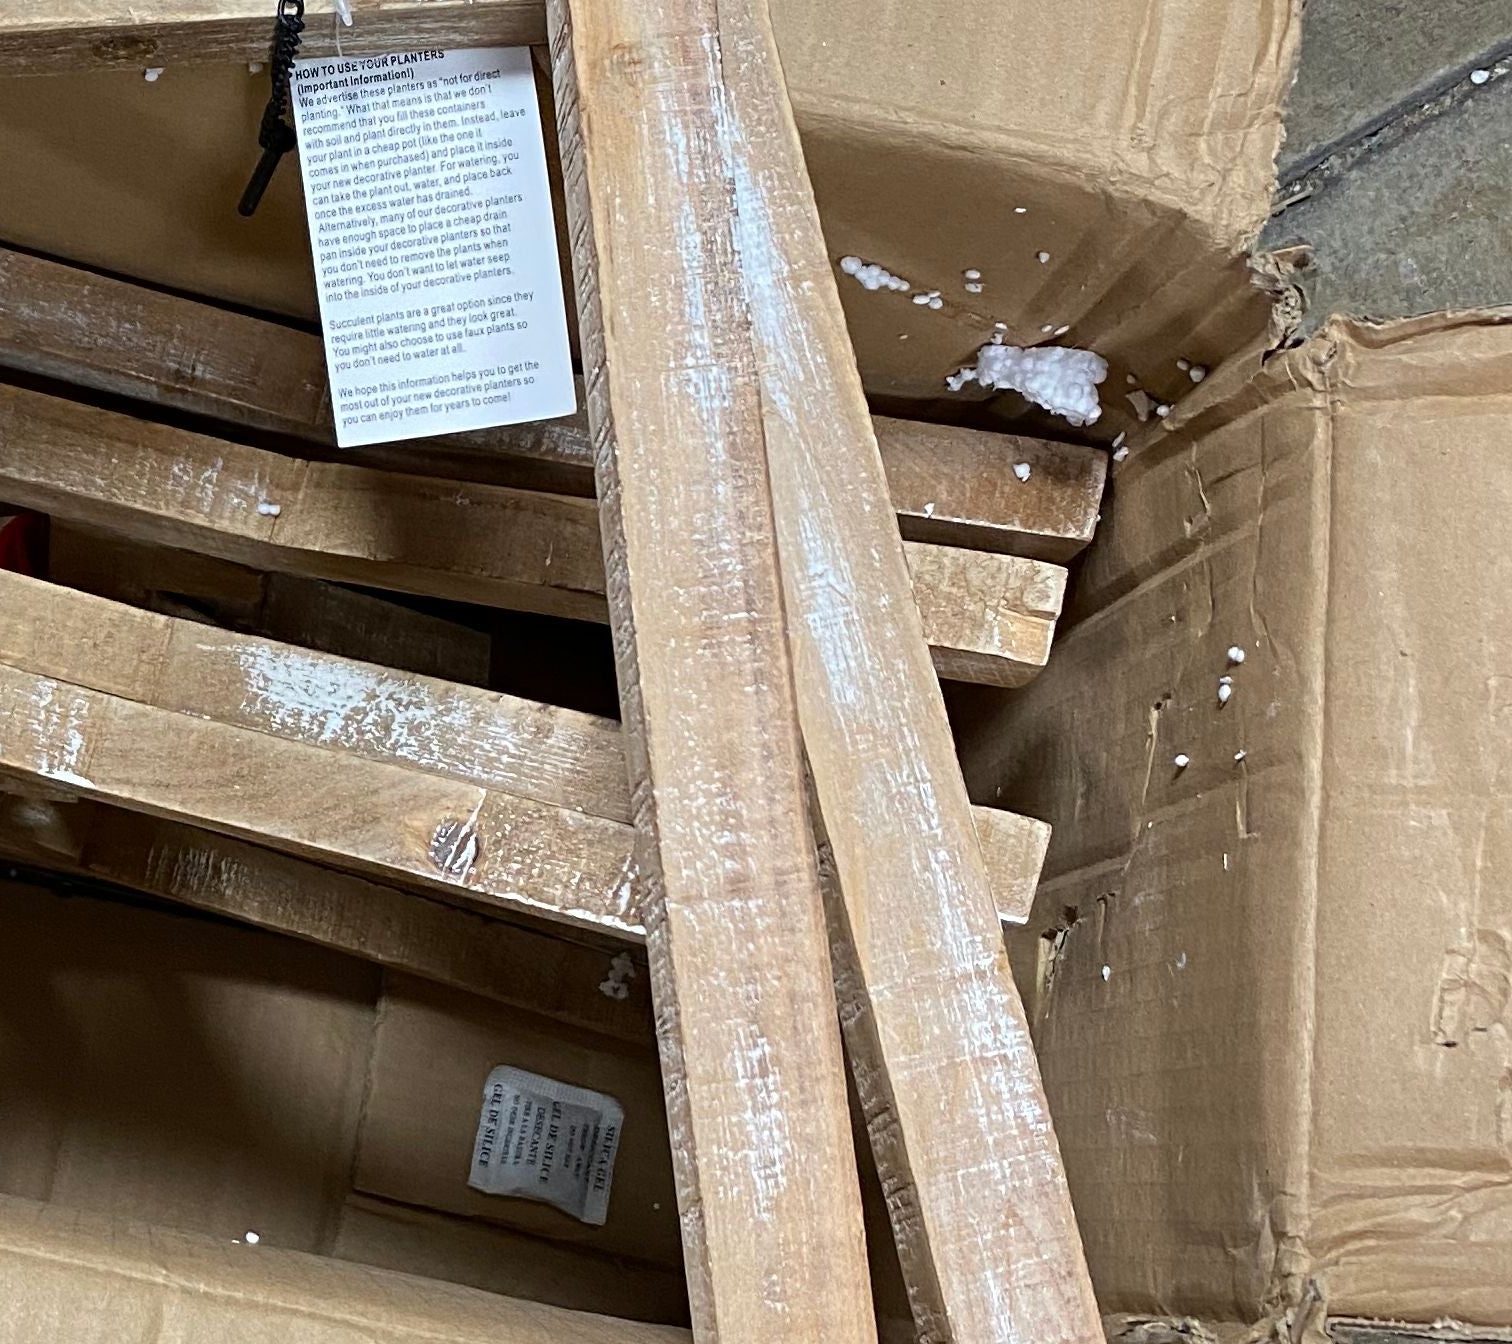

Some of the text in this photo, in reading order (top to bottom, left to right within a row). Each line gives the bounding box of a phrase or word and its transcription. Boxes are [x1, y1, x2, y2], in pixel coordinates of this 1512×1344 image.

[294, 66, 319, 80] HOW
[336, 61, 358, 73] USE
[358, 55, 388, 69] YOUR
[390, 48, 444, 65] PLANTERS
[316, 90, 358, 105] advertise
[359, 87, 385, 98] these
[387, 81, 424, 96] planters
[459, 73, 472, 83] for
[473, 69, 500, 80] direct
[345, 102, 370, 115] What
[371, 99, 390, 111] that
[391, 96, 422, 107] means
[432, 90, 452, 101] that
[308, 166, 339, 177] comes
[350, 159, 375, 171] when
[377, 150, 429, 168] purchased)
[430, 146, 448, 158] and
[449, 144, 475, 157] place
[484, 138, 512, 150] inside
[310, 181, 330, 194] your
[332, 178, 351, 188] new
[353, 170, 401, 184] decorative
[439, 160, 456, 171] For
[501, 152, 519, 164] you
[312, 196, 329, 205] can
[330, 191, 351, 202] take
[352, 189, 367, 199] the
[368, 184, 392, 198] plant
[443, 172, 461, 185] and
[462, 171, 488, 184] place
[489, 165, 512, 177] back
[379, 212, 404, 223] many
[417, 208, 432, 217] our
[434, 200, 483, 214] decorative
[484, 193, 522, 209] planters
[317, 236, 340, 247] have
[342, 230, 376, 243] enough
[378, 226, 406, 239] space
[418, 220, 443, 233] place
[453, 214, 482, 226] cheap
[482, 209, 507, 221] drain
[321, 265, 338, 277] you
[364, 255, 388, 268] need
[400, 250, 435, 262] remove
[436, 247, 451, 257] the
[452, 242, 481, 256] plants
[482, 238, 508, 249] when
[366, 271, 385, 281] You
[411, 263, 434, 275] want
[445, 259, 458, 269] let
[458, 256, 485, 267] water
[486, 253, 510, 263] seep
[329, 315, 374, 330] Succulent
[376, 311, 404, 325] plants
[405, 309, 421, 318] are
[430, 302, 455, 316] great
[456, 298, 485, 311] option
[487, 294, 512, 305] since
[513, 291, 533, 301] they
[330, 331, 363, 344] require
[364, 327, 385, 338] little
[386, 322, 426, 335] watering
[427, 317, 445, 329] and
[446, 316, 466, 326] they
[468, 310, 488, 322] look
[332, 347, 350, 357] You
[351, 342, 377, 355] might
[378, 340, 398, 350] also
[399, 335, 433, 347] choose
[445, 331, 463, 340] use
[464, 327, 484, 337] faux
[486, 322, 514, 335] plants
[340, 400, 363, 412] most
[363, 397, 379, 408] out
[390, 395, 411, 407] your
[412, 392, 432, 401] new
[433, 384, 482, 398] decorative
[483, 378, 521, 393] planters
[354, 385, 378, 396] hope
[378, 381, 396, 392] this
[397, 374, 450, 389] information
[450, 369, 476, 381] helps
[478, 368, 495, 379] you
[507, 362, 523, 375] get
[524, 360, 539, 370] the
[342, 417, 358, 428] you
[359, 414, 377, 422] can
[378, 410, 403, 421] enjoy
[404, 406, 428, 416] them
[429, 403, 442, 412] for
[444, 400, 470, 413] years
[482, 391, 510, 404] come!
